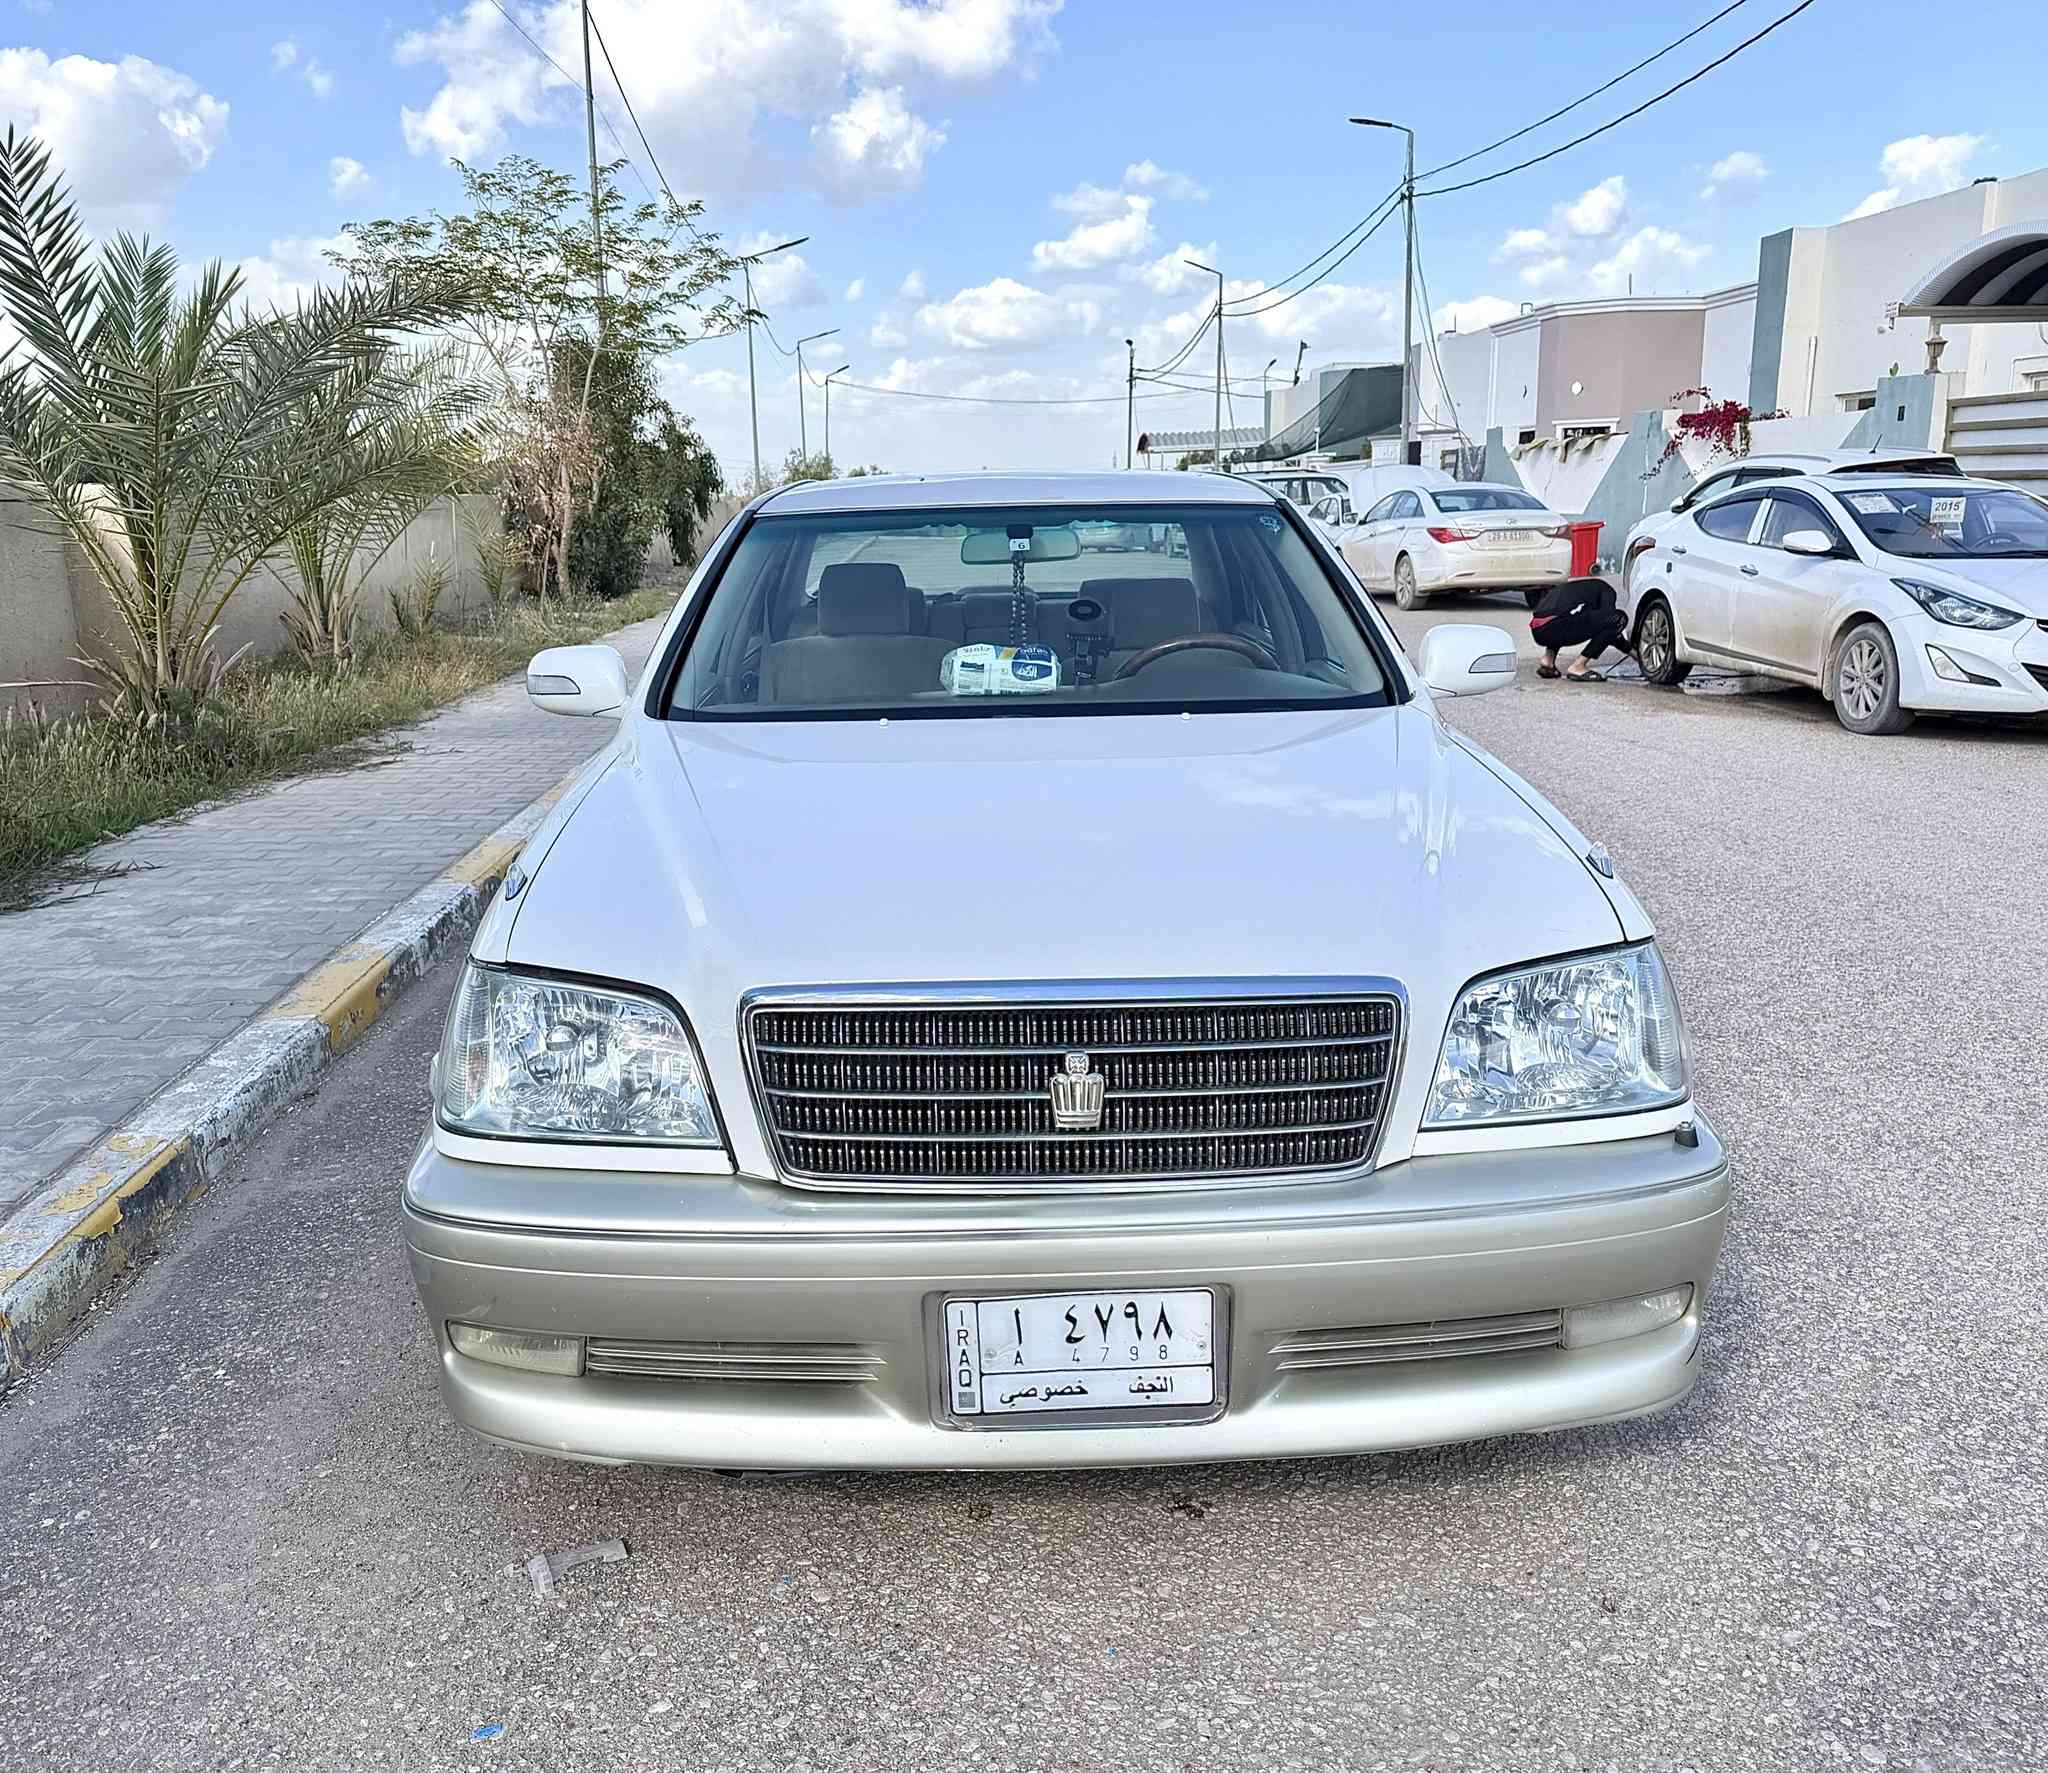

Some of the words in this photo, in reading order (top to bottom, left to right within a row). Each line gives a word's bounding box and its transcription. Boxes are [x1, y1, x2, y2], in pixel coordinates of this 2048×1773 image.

[1934, 501, 1961, 513] 2015
[1064, 1300, 1174, 1345] ٤٧٩٨
[956, 1309, 973, 1388] IRAQ
[1014, 1351, 1024, 1367] A
[999, 1378, 1089, 1409] خصوصي
[1128, 1375, 1175, 1400] النجف
